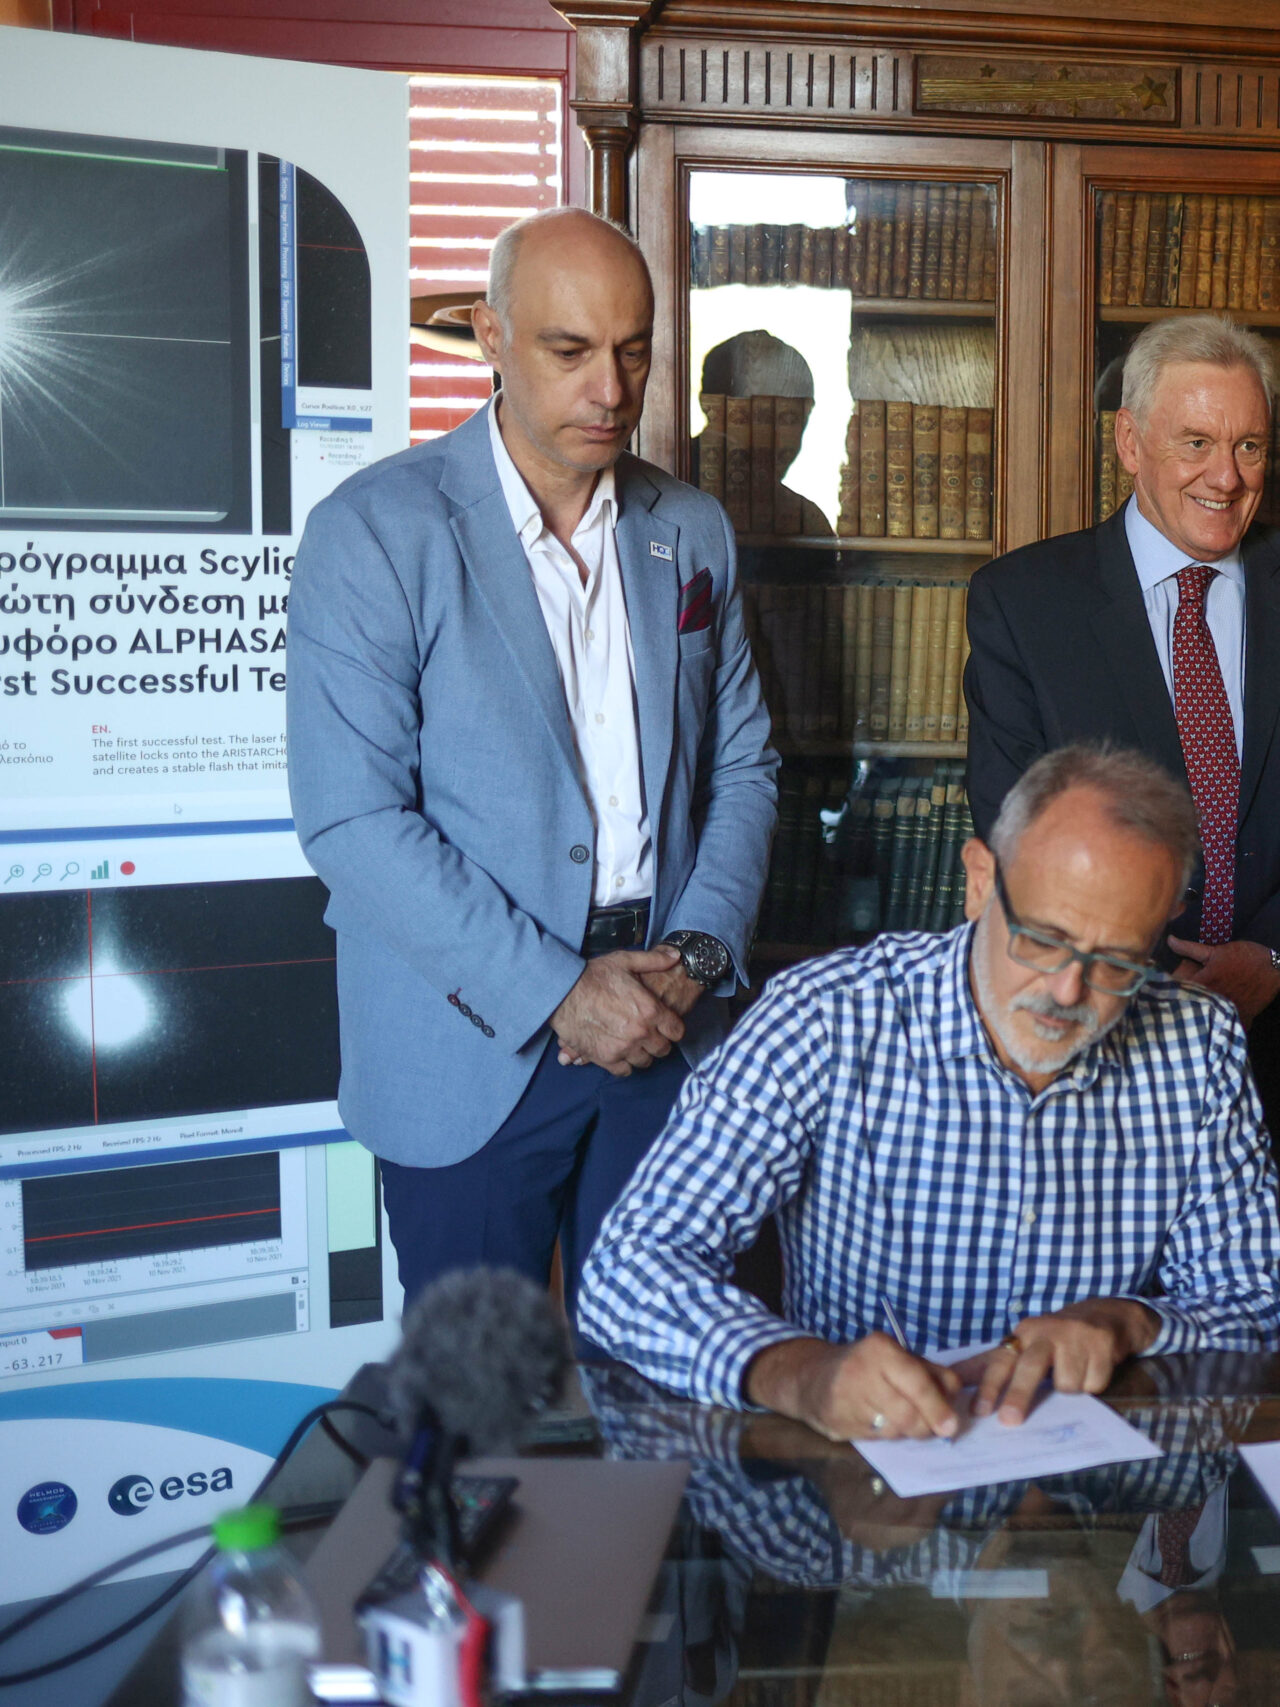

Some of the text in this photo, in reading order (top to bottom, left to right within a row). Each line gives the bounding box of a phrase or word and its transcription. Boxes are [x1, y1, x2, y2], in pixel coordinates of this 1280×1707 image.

[0, 582, 75, 621] ώτη
[89, 584, 245, 621] σύνδεση
[129, 627, 287, 654] ALPHASA
[0, 671, 37, 696] st
[51, 664, 239, 695] Successful
[91, 724, 111, 734] EN.
[13, 742, 27, 750] το
[92, 737, 113, 748] The
[117, 737, 138, 748] first
[141, 735, 198, 747] successful
[201, 736, 226, 746] test.
[228, 734, 249, 744] The
[252, 734, 277, 744] laser
[92, 751, 137, 762] satellite
[140, 750, 169, 760] locks
[172, 750, 198, 760] onto
[201, 749, 220, 759] the
[92, 764, 114, 776] and
[117, 764, 159, 775] creates
[162, 766, 169, 774] a
[172, 762, 206, 773] stable
[209, 761, 234, 772] flash
[237, 760, 258, 771] that
[4, 1353, 63, 1371] -63.217
[159, 1467, 234, 1501] esa
